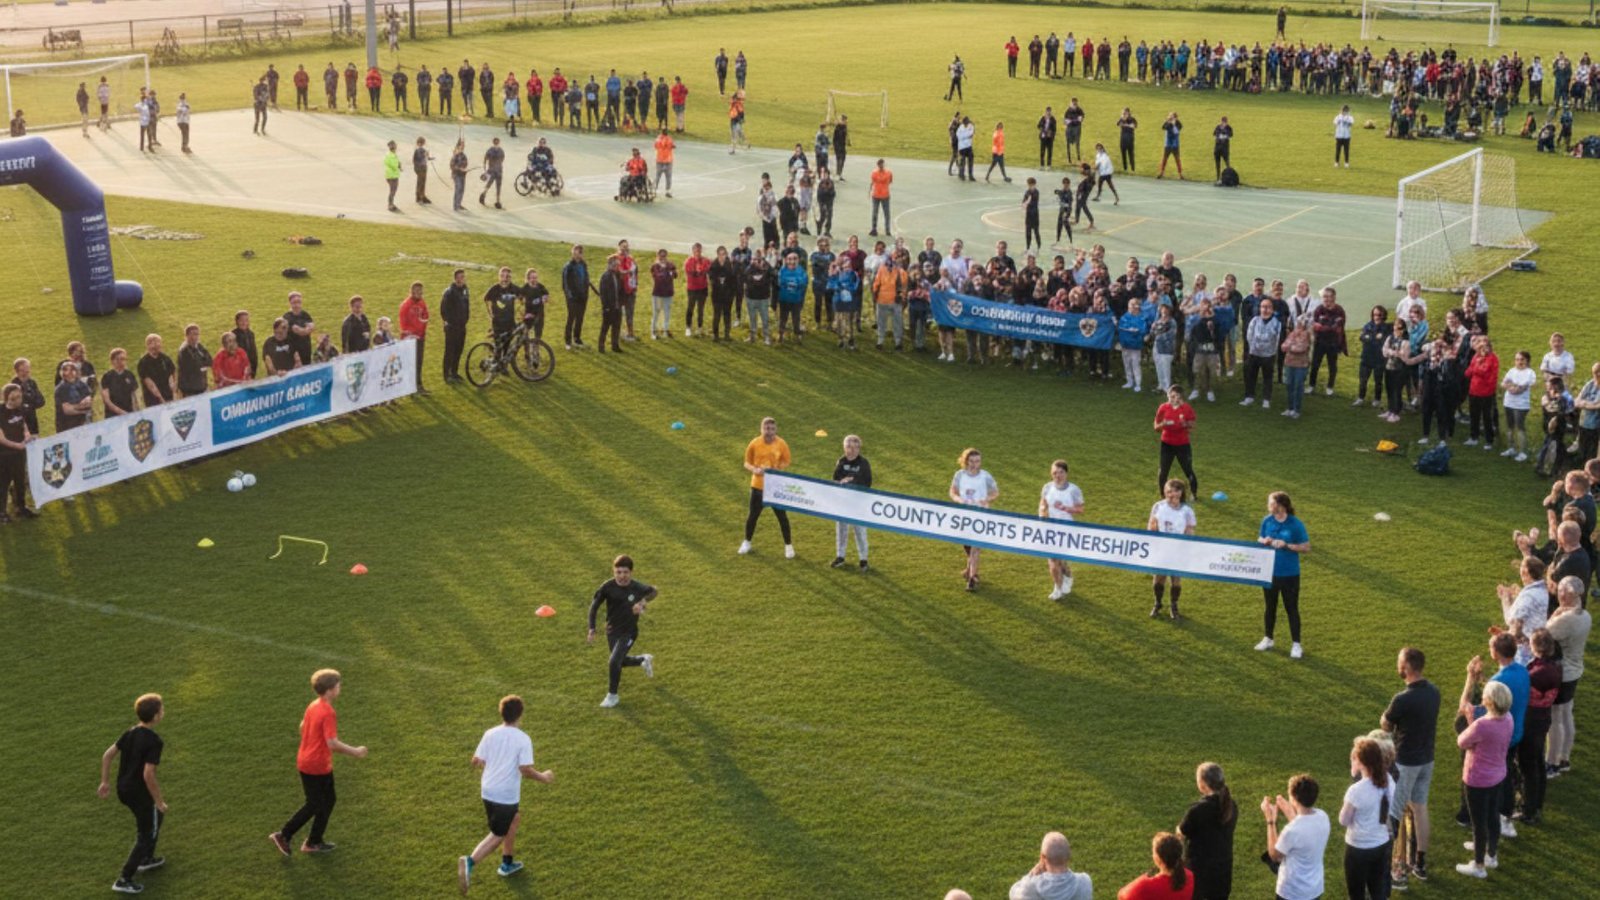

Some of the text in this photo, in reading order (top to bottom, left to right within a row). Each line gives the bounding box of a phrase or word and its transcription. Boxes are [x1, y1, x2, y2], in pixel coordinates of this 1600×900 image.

[871, 501, 1150, 559] COUNTY SPORTS PARTNERSHIPS
